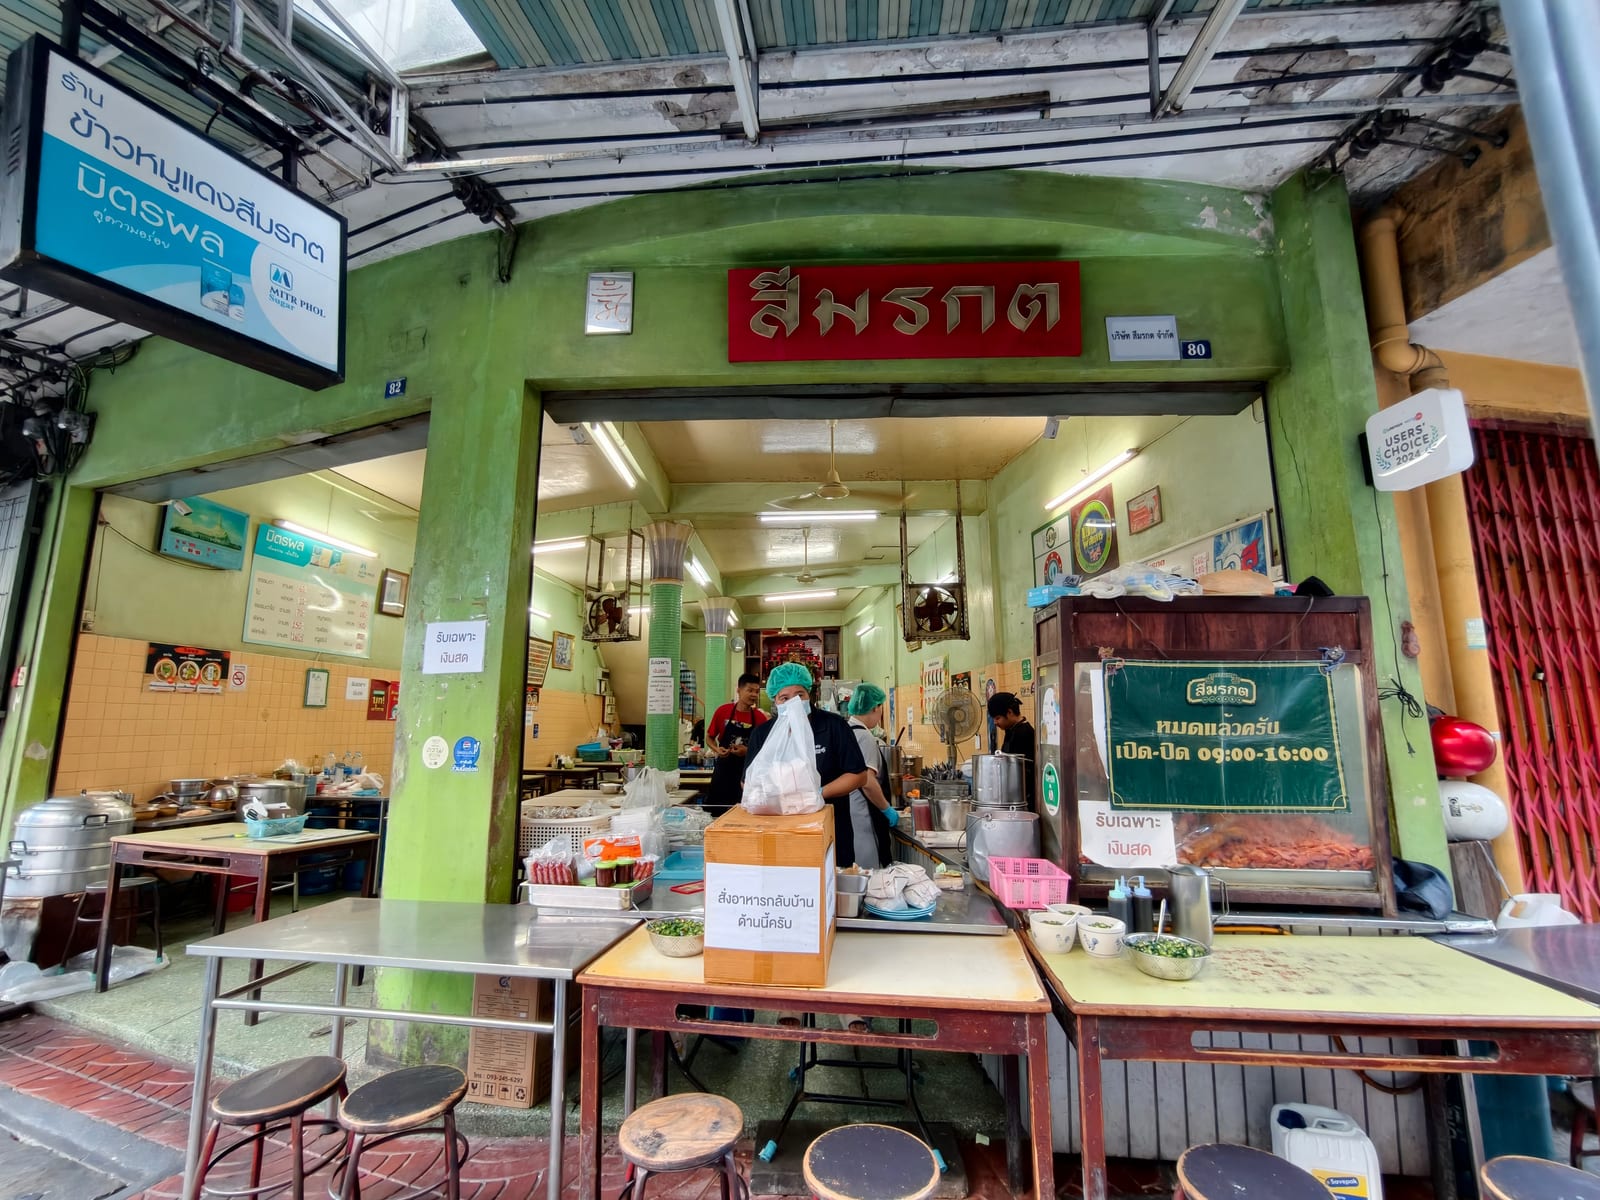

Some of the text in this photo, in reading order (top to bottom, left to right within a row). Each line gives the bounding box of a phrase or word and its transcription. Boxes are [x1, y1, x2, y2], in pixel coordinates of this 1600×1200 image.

[60, 70, 104, 108] ร้าน
[69, 108, 325, 263] ข้าวหมูแดงสีมรกต
[77, 161, 225, 258] มิตรพล
[269, 286, 327, 318] MITR PHOL
[749, 265, 1061, 340] สีมรกต
[1111, 329, 1175, 341] บริษัท สีมรกต จำกัด
[1187, 343, 1206, 356] 80
[389, 381, 402, 394] 82
[1385, 422, 1426, 447] USERS'
[1383, 433, 1430, 459] CHOICE
[1396, 449, 1421, 466] 2024
[266, 529, 305, 551] มิตรพล
[436, 632, 476, 643] รับเฉพาะ
[440, 652, 469, 663] เงินสด
[1195, 682, 1249, 697] สีมรกต
[1156, 713, 1280, 736] หมดแล้วครับ
[1116, 742, 1329, 763] เปิด-ปิด 09:00-16:00
[1096, 812, 1161, 829] รับเฉพาะ
[1108, 840, 1152, 856] เงินสด
[718, 888, 814, 908] สั่งอาหารกลับบ้าน
[738, 912, 793, 929] ด้านนี้ครับ
